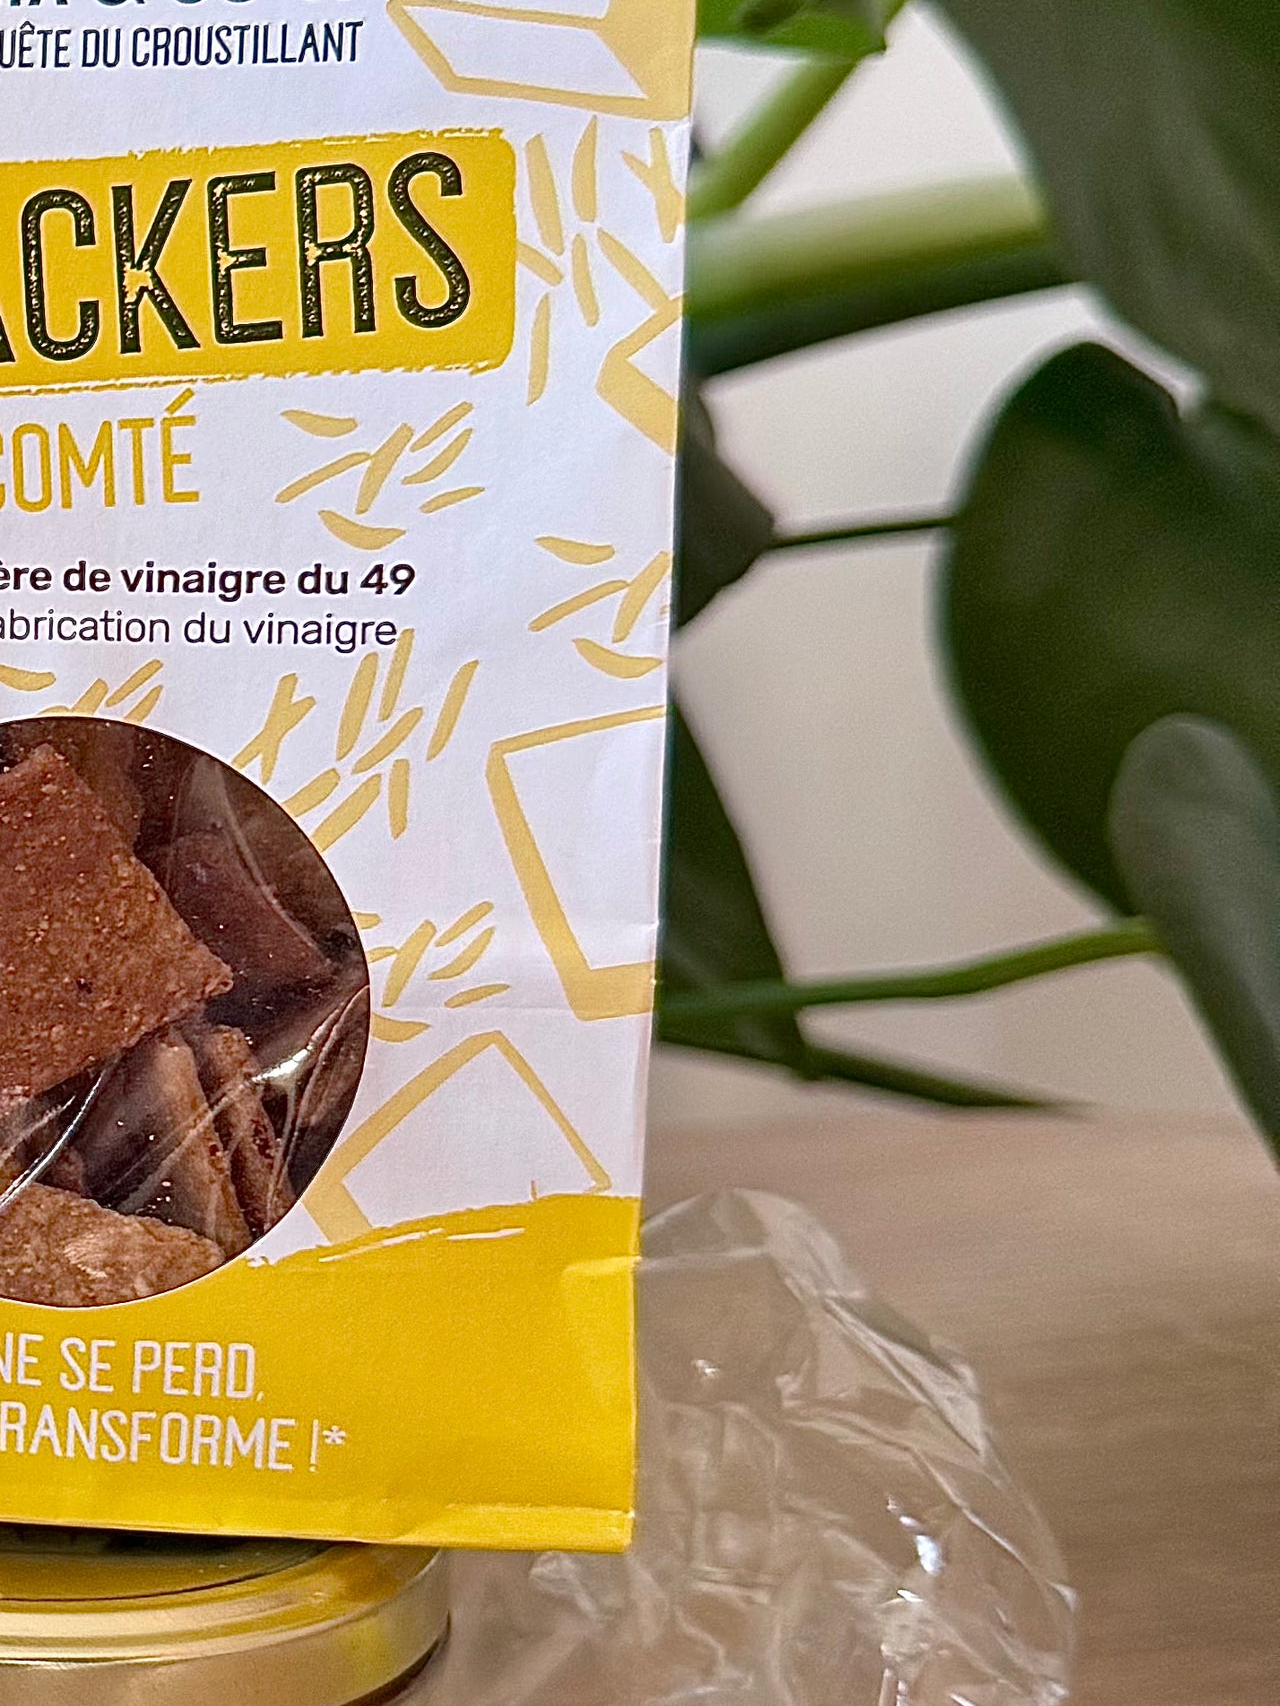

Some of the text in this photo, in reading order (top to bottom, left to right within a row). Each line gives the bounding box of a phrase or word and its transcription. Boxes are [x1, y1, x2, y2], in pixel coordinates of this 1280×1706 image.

[81, 28, 121, 67] DU
[132, 21, 364, 66] CROUSTILLANT
[63, 560, 110, 592] de
[121, 562, 286, 602] vinaigre
[297, 563, 348, 594] du
[361, 564, 416, 595] 49
[184, 612, 229, 644] du
[242, 614, 397, 653] vinaigre
[59, 1337, 116, 1393] SE
[131, 1340, 265, 1402] PERD,
